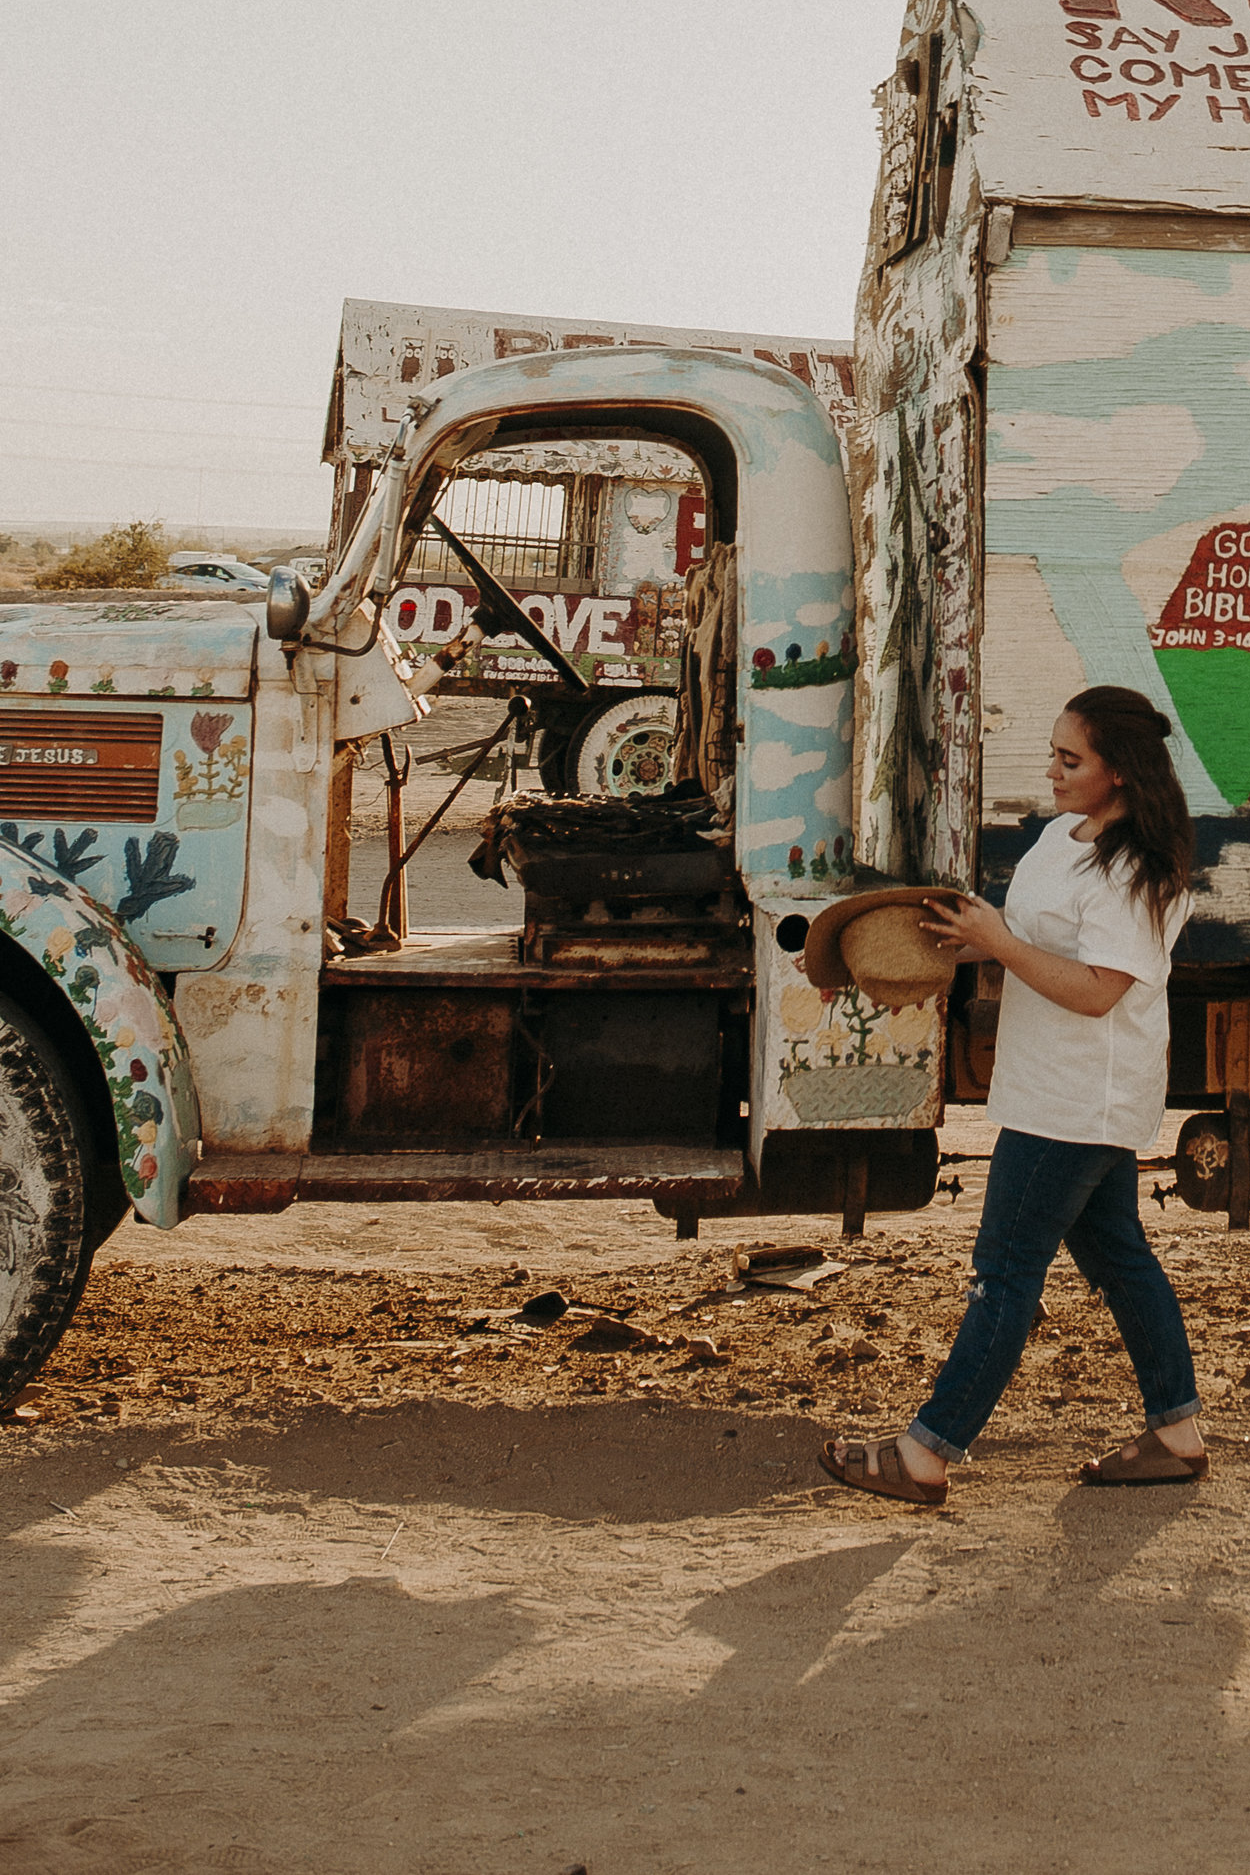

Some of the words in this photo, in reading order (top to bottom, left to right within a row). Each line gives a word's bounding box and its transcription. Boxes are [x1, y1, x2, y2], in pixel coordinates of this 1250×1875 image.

[1065, 20, 1180, 53] SAY
[1083, 89, 1180, 122] MY
[384, 586, 464, 644] OD
[1151, 627, 1207, 647] JOHN
[15, 748, 94, 765] JESUS.
